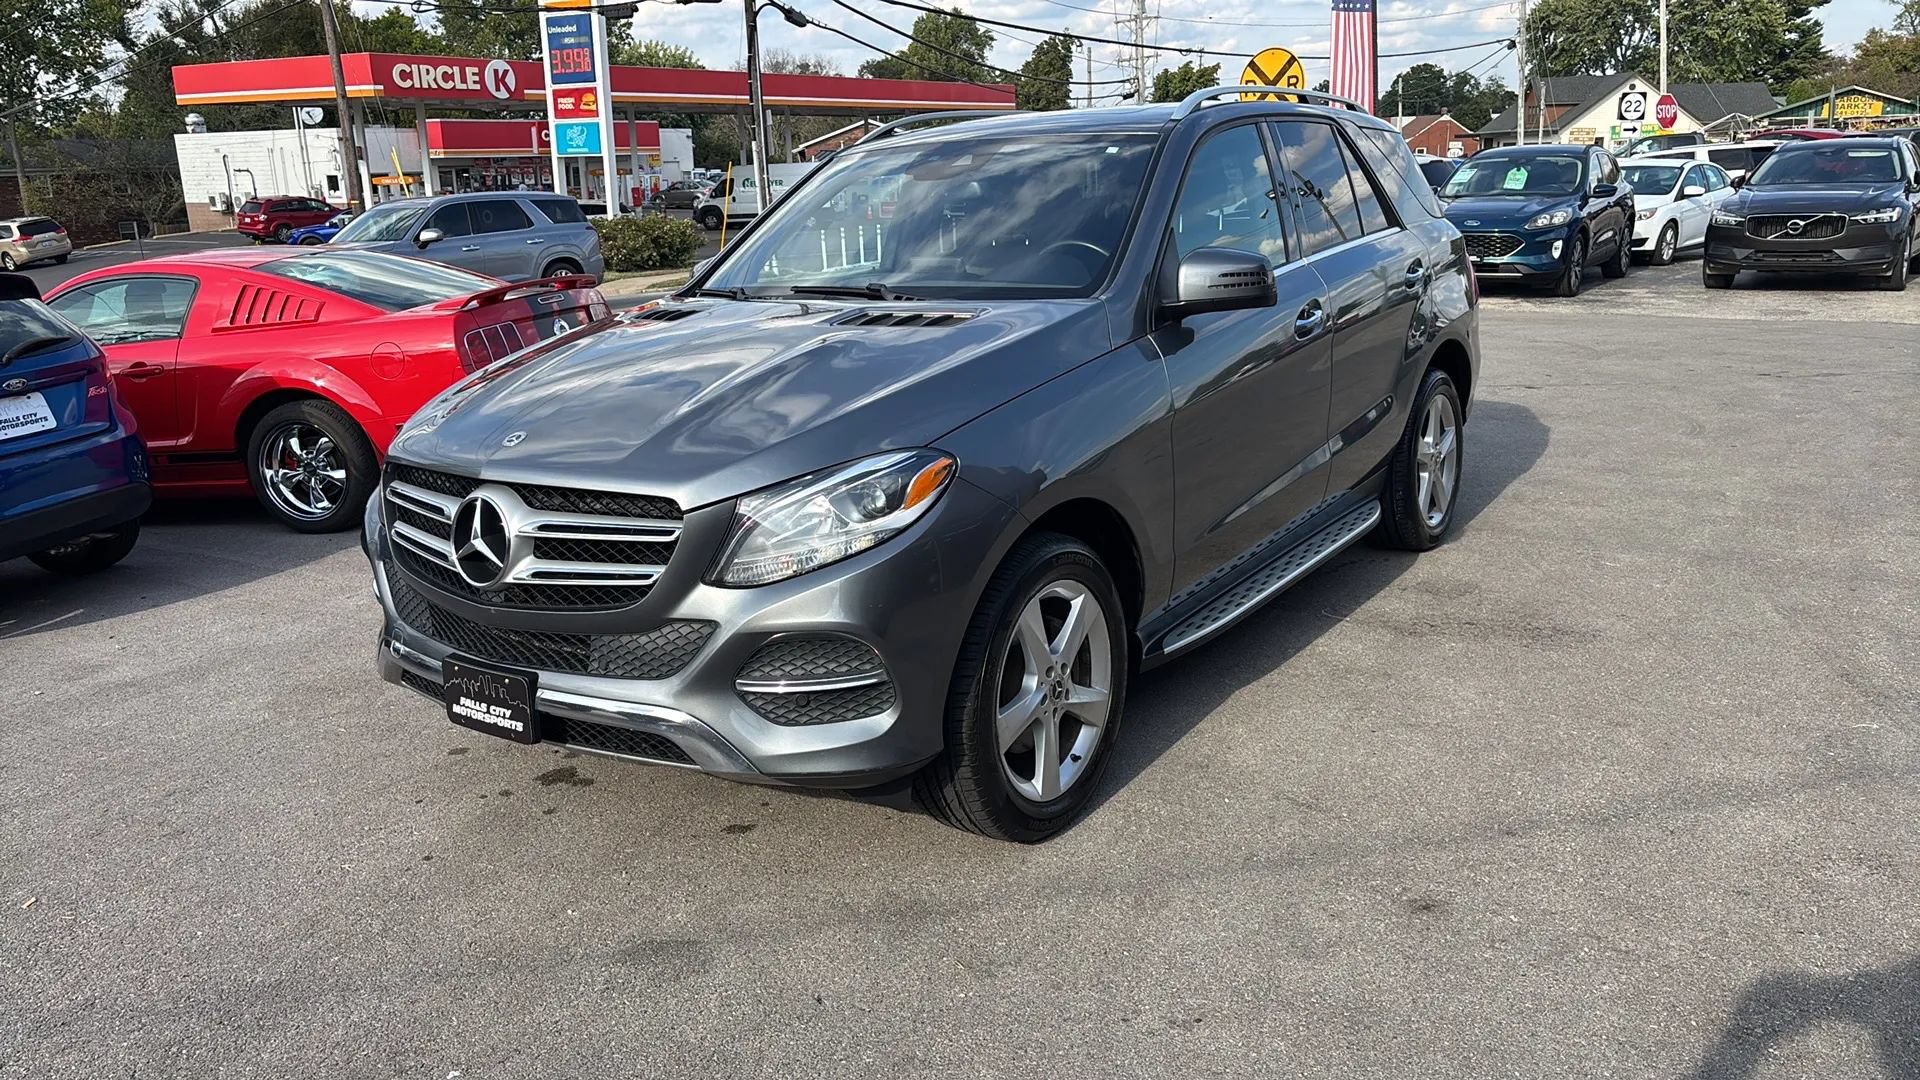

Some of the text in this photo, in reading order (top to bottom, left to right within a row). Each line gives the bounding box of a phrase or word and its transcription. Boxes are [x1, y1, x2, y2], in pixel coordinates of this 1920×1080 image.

[548, 24, 577, 33] Unleaded
[392, 63, 514, 93] CIRCLE K
[1287, 75, 1299, 88] R
[1624, 100, 1642, 113] 22
[1657, 105, 1677, 119] STOP
[0, 416, 49, 431] OTORSPORTS
[22, 412, 38, 421] CITY
[460, 696, 512, 719] FALLS CITY
[452, 703, 524, 732] MOTORSPORTS
